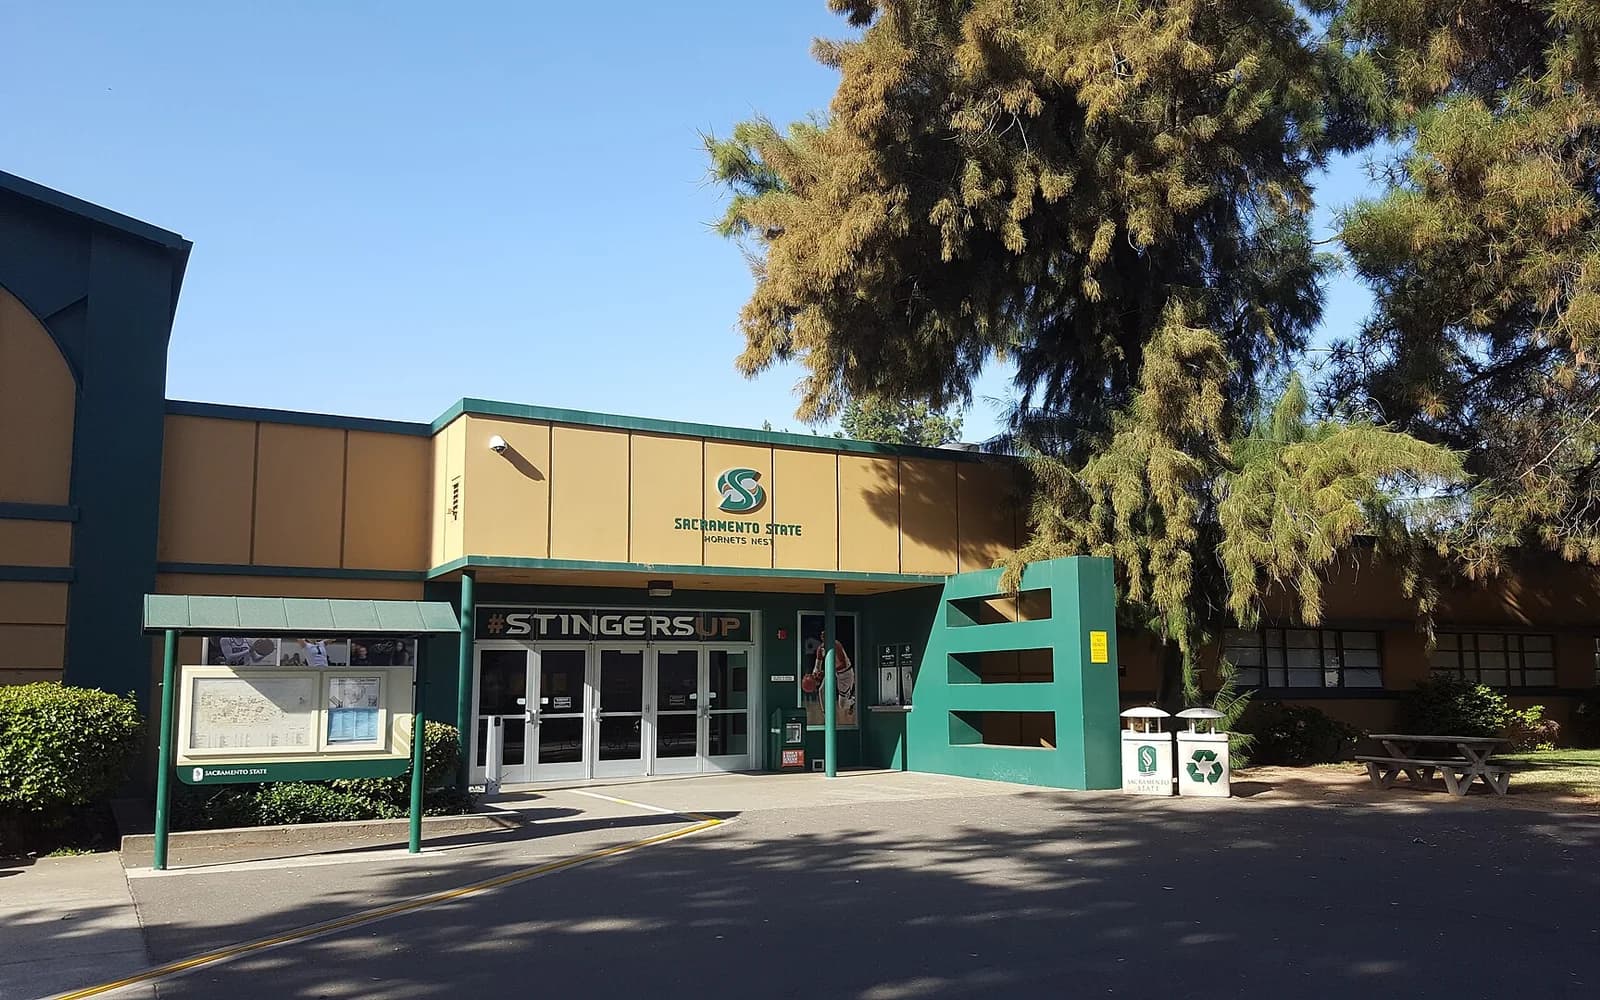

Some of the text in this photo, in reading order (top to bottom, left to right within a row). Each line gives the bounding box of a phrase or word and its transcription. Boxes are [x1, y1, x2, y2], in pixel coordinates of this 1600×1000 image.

[674, 518, 802, 536] SACRAMENTO STATE
[704, 535, 747, 545] HORNETS
[487, 613, 741, 637] #STINGERSUP
